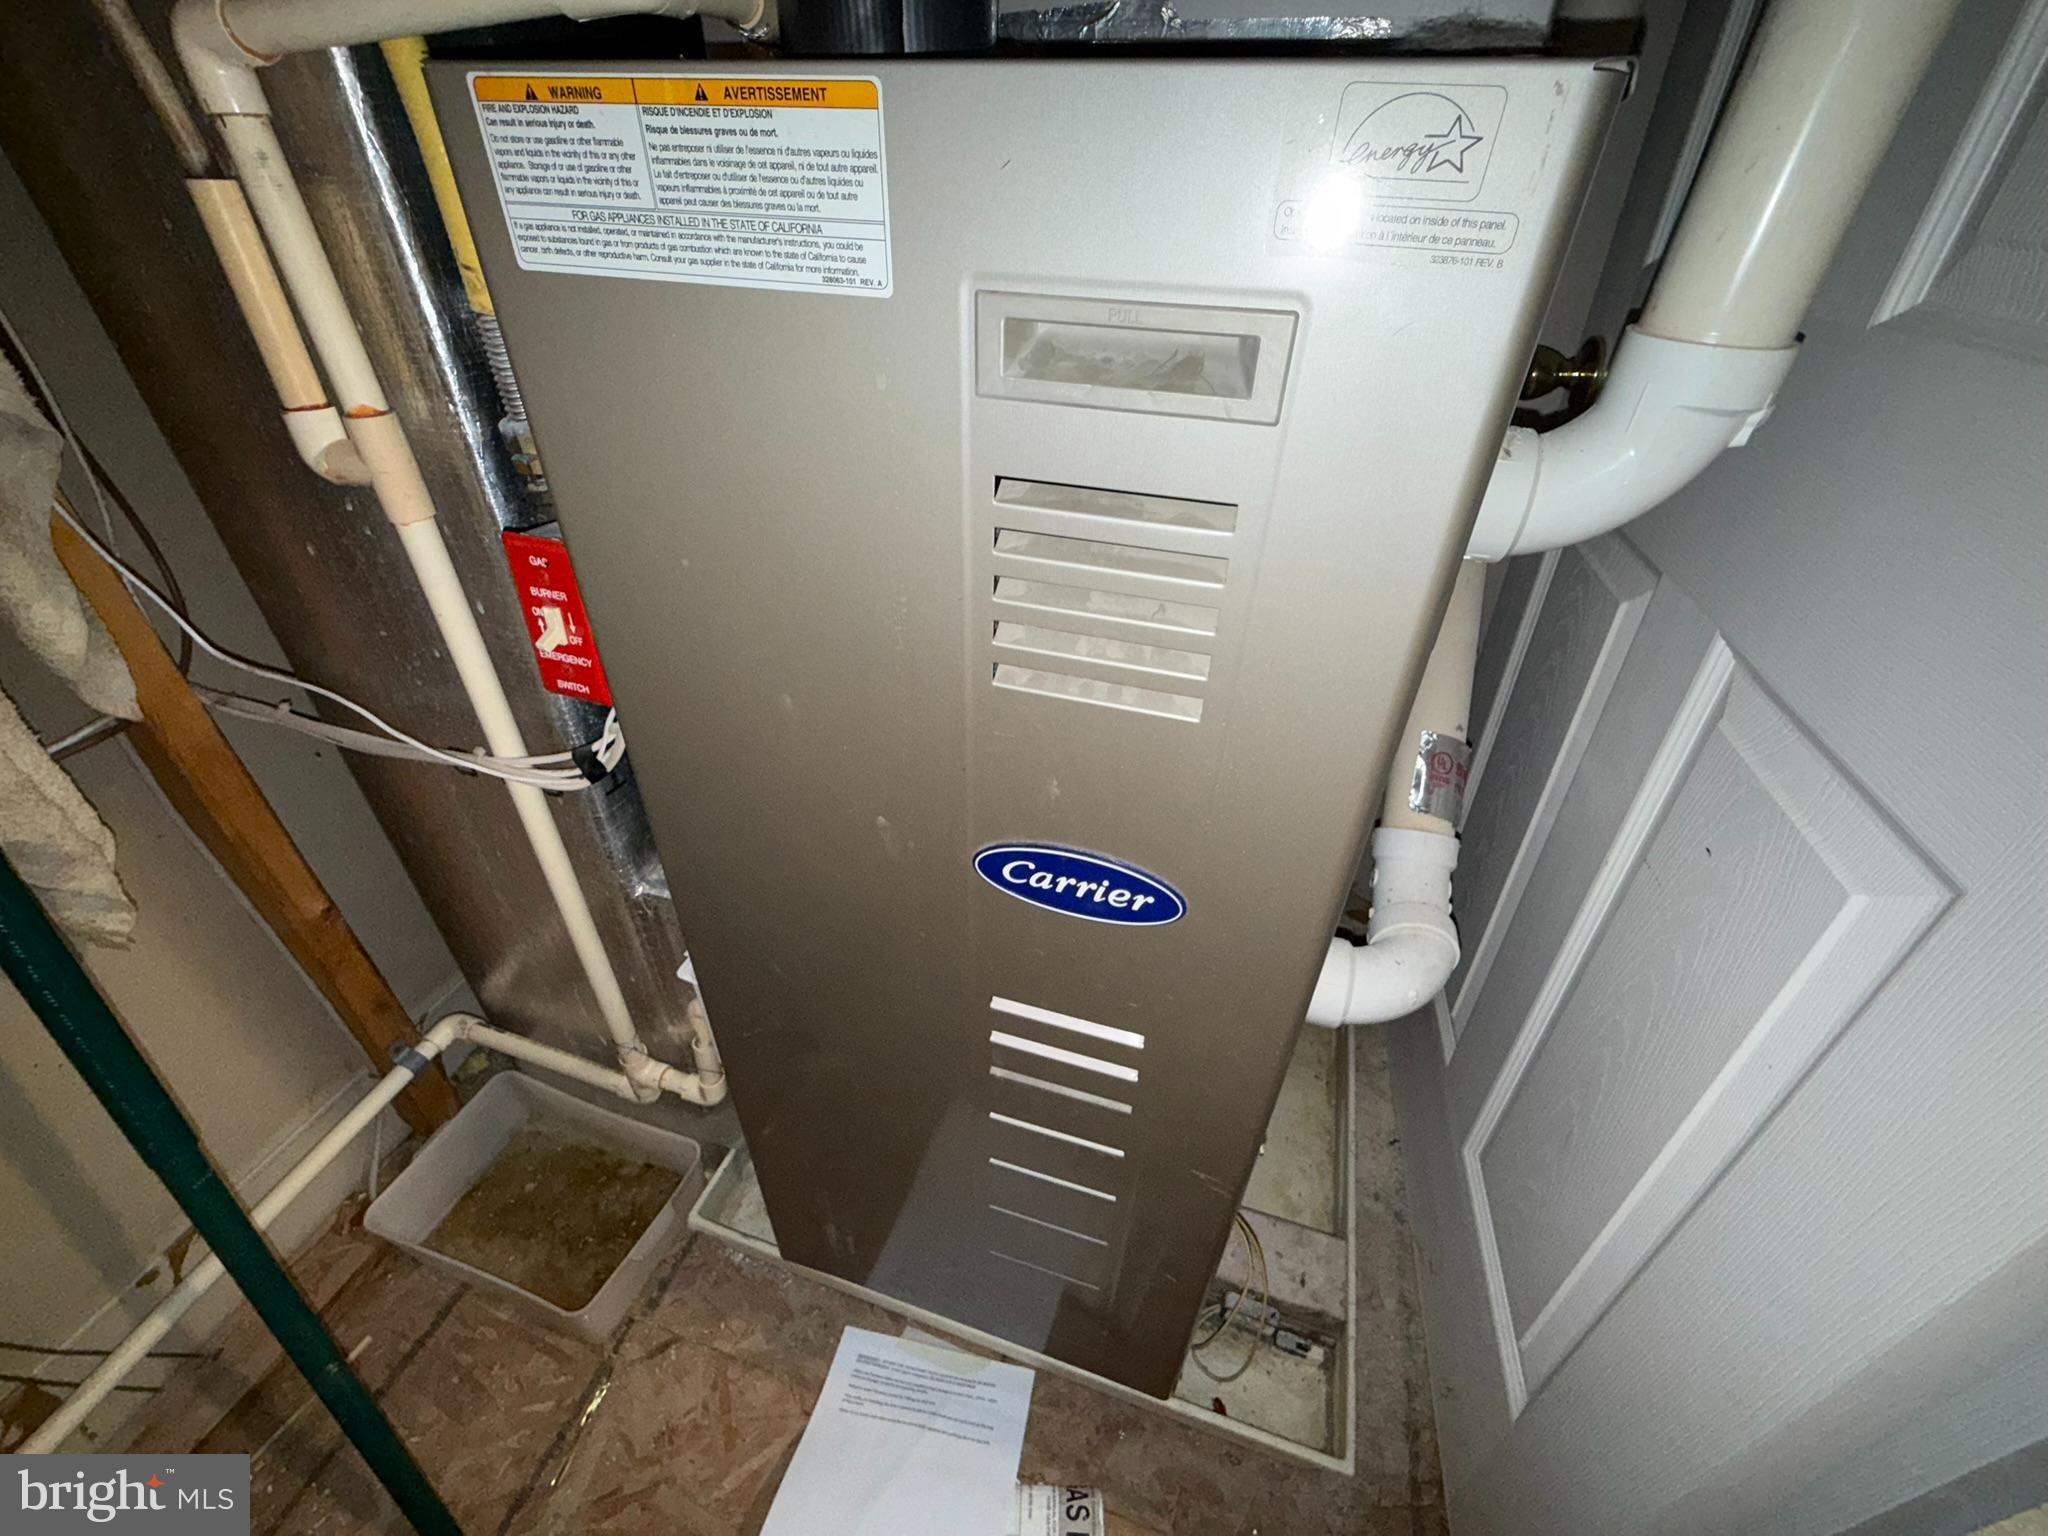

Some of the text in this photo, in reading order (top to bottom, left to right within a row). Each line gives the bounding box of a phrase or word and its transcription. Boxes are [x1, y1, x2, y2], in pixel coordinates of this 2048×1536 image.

[548, 84, 603, 99] WARNING
[723, 86, 827, 102] AVERTISSEMENT
[482, 104, 580, 114] FIRE AND EXPLOSION HAZARD
[642, 107, 773, 119] RISQUE D'INCENDIE ET D'EXPLOSION
[486, 118, 498, 126] Can
[499, 118, 517, 127] result
[518, 118, 524, 127] in
[525, 119, 548, 128] serious
[549, 119, 567, 130] injury
[576, 120, 596, 129] death.
[646, 124, 669, 136] Risque
[670, 125, 678, 134] de
[680, 125, 712, 135] blessures
[714, 128, 738, 138] graves
[750, 127, 758, 136] de
[760, 127, 778, 137] mort.
[649, 142, 658, 152] Ne
[659, 145, 671, 153] pas
[706, 144, 712, 153] ni
[736, 145, 744, 154] de
[777, 146, 783, 156] ni
[813, 150, 839, 159] vapeurs
[842, 150, 850, 158] ou
[693, 158, 708, 167] dans
[709, 158, 715, 167] le
[748, 159, 756, 169] de
[758, 160, 767, 169] cet
[799, 161, 804, 170] ni
[806, 161, 814, 171] de
[816, 162, 829, 171] tout
[831, 162, 848, 172] autre
[654, 170, 662, 178] Le
[663, 170, 672, 179] fait
[749, 174, 758, 182] de
[657, 185, 681, 194] vapeurs
[723, 186, 727, 194] à
[758, 188, 766, 196] de
[768, 188, 778, 197] cet
[817, 190, 825, 199] de
[827, 190, 839, 200] tout
[841, 191, 858, 200] autre
[684, 198, 697, 208] peut
[720, 200, 732, 208] des
[764, 204, 786, 212] graves
[805, 204, 821, 212] mort.
[572, 210, 823, 234] FOR GAS APPLIANCES INSTALLED IN THE STATE OF CALIFORNIA
[1409, 216, 1421, 225] on
[1422, 216, 1449, 227] inside
[1451, 216, 1462, 227] of
[1462, 217, 1478, 229] this
[1429, 234, 1440, 244] de
[1441, 236, 1453, 245] ce
[1475, 258, 1494, 268] REV.
[1496, 259, 1504, 268] B
[1108, 307, 1144, 325] PULL
[530, 586, 568, 602] BURNER
[569, 636, 583, 647] OFF
[557, 679, 590, 694] SWITCH
[1002, 860, 1154, 911] Carrier
